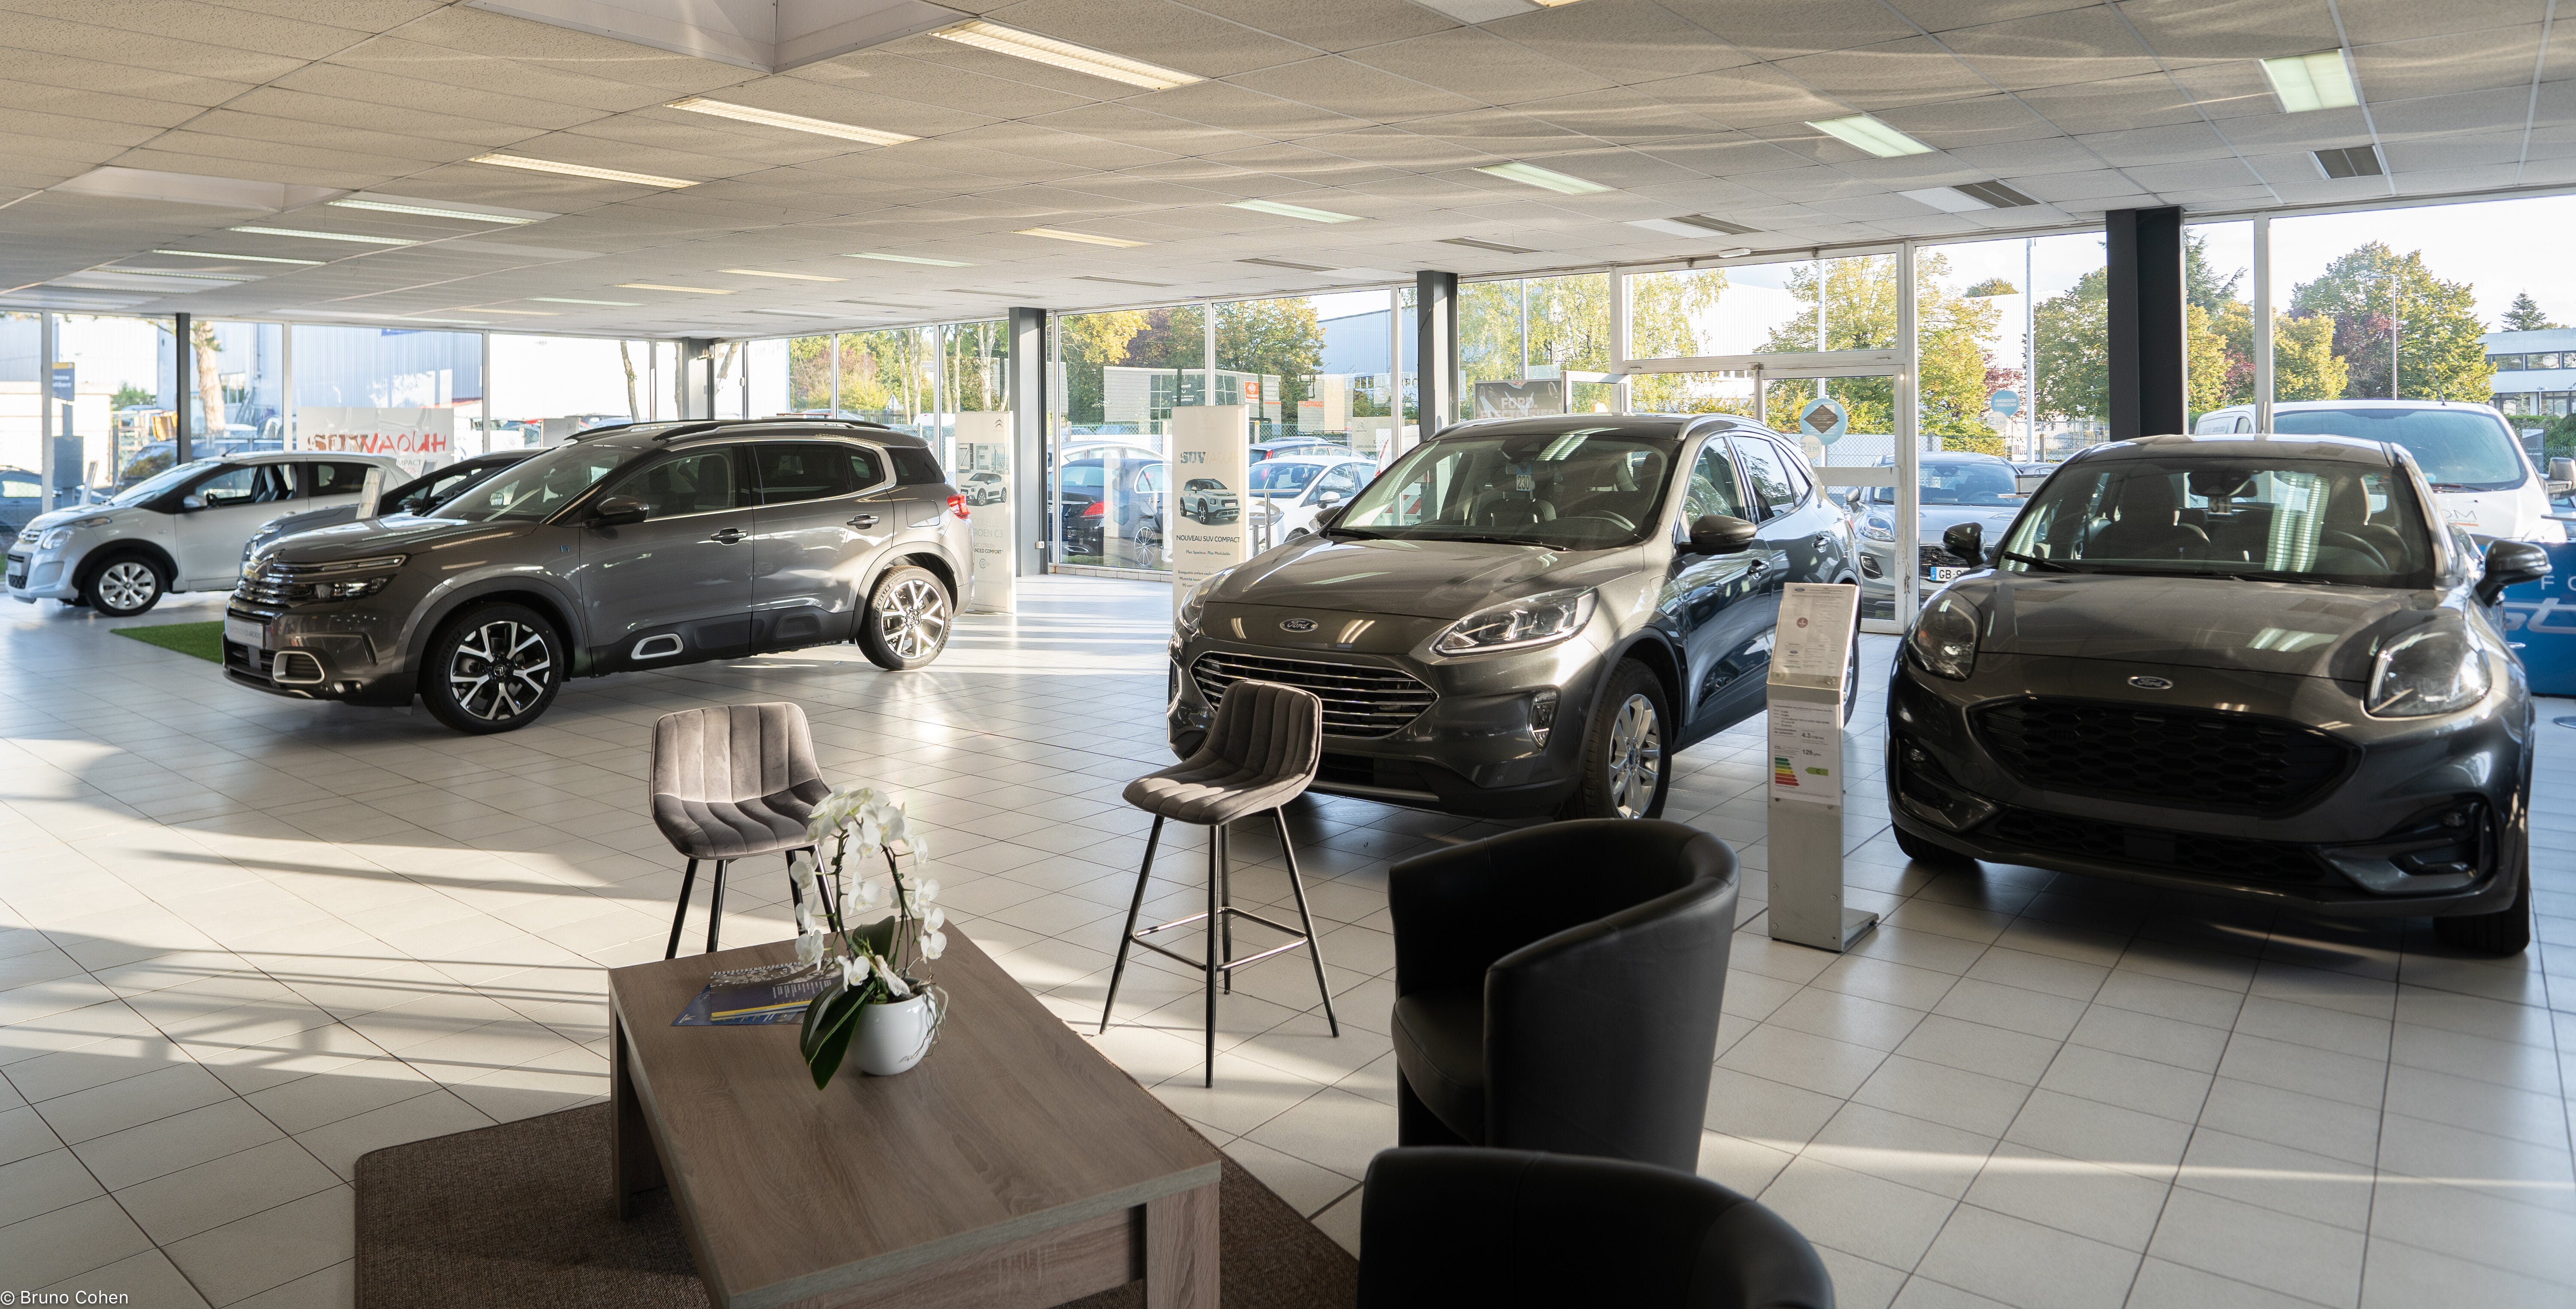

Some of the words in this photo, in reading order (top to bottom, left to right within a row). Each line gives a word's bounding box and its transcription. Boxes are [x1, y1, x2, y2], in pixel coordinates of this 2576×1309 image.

[1501, 397, 1538, 409] FORD.
[1517, 475, 1530, 490] 230
[2138, 679, 2163, 687] Ford
